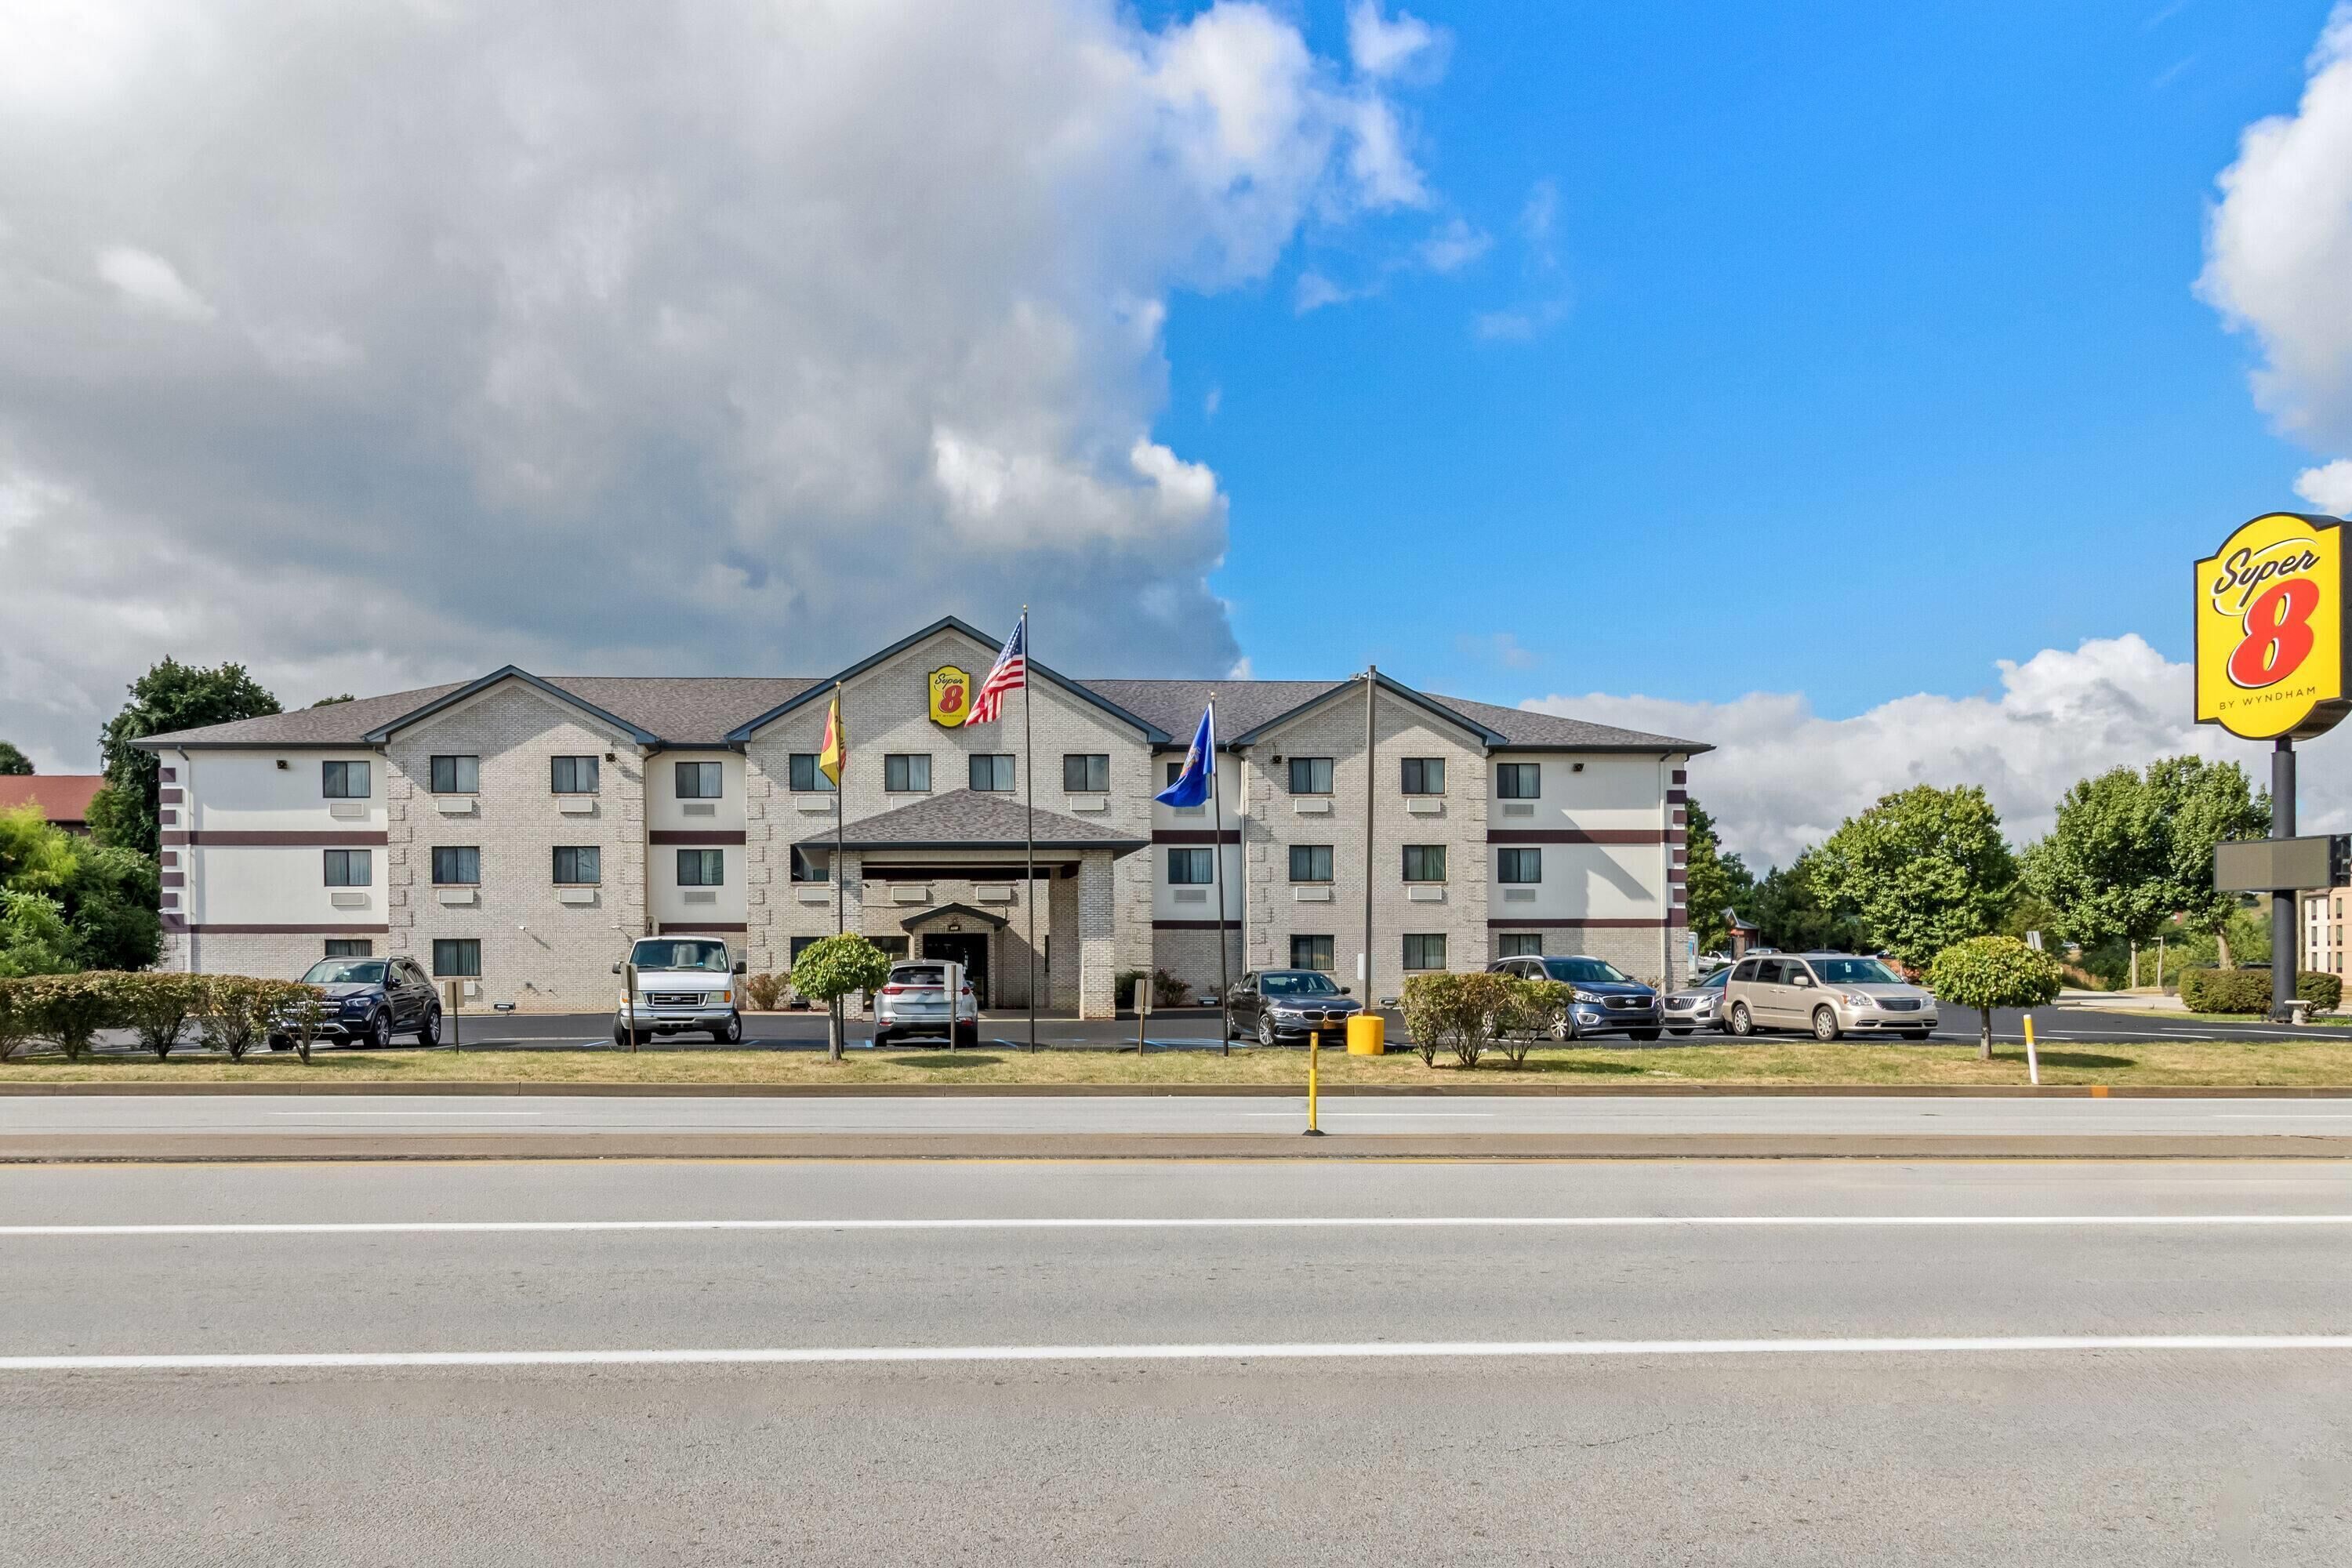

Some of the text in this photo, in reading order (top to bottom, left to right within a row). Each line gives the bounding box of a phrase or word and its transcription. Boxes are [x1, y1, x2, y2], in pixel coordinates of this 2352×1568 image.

[2211, 546, 2321, 609] Super
[2227, 578, 2320, 689] 8
[935, 673, 964, 689] Super
[938, 684, 964, 713] 8
[2220, 686, 2316, 710] BY WYNDHAM
